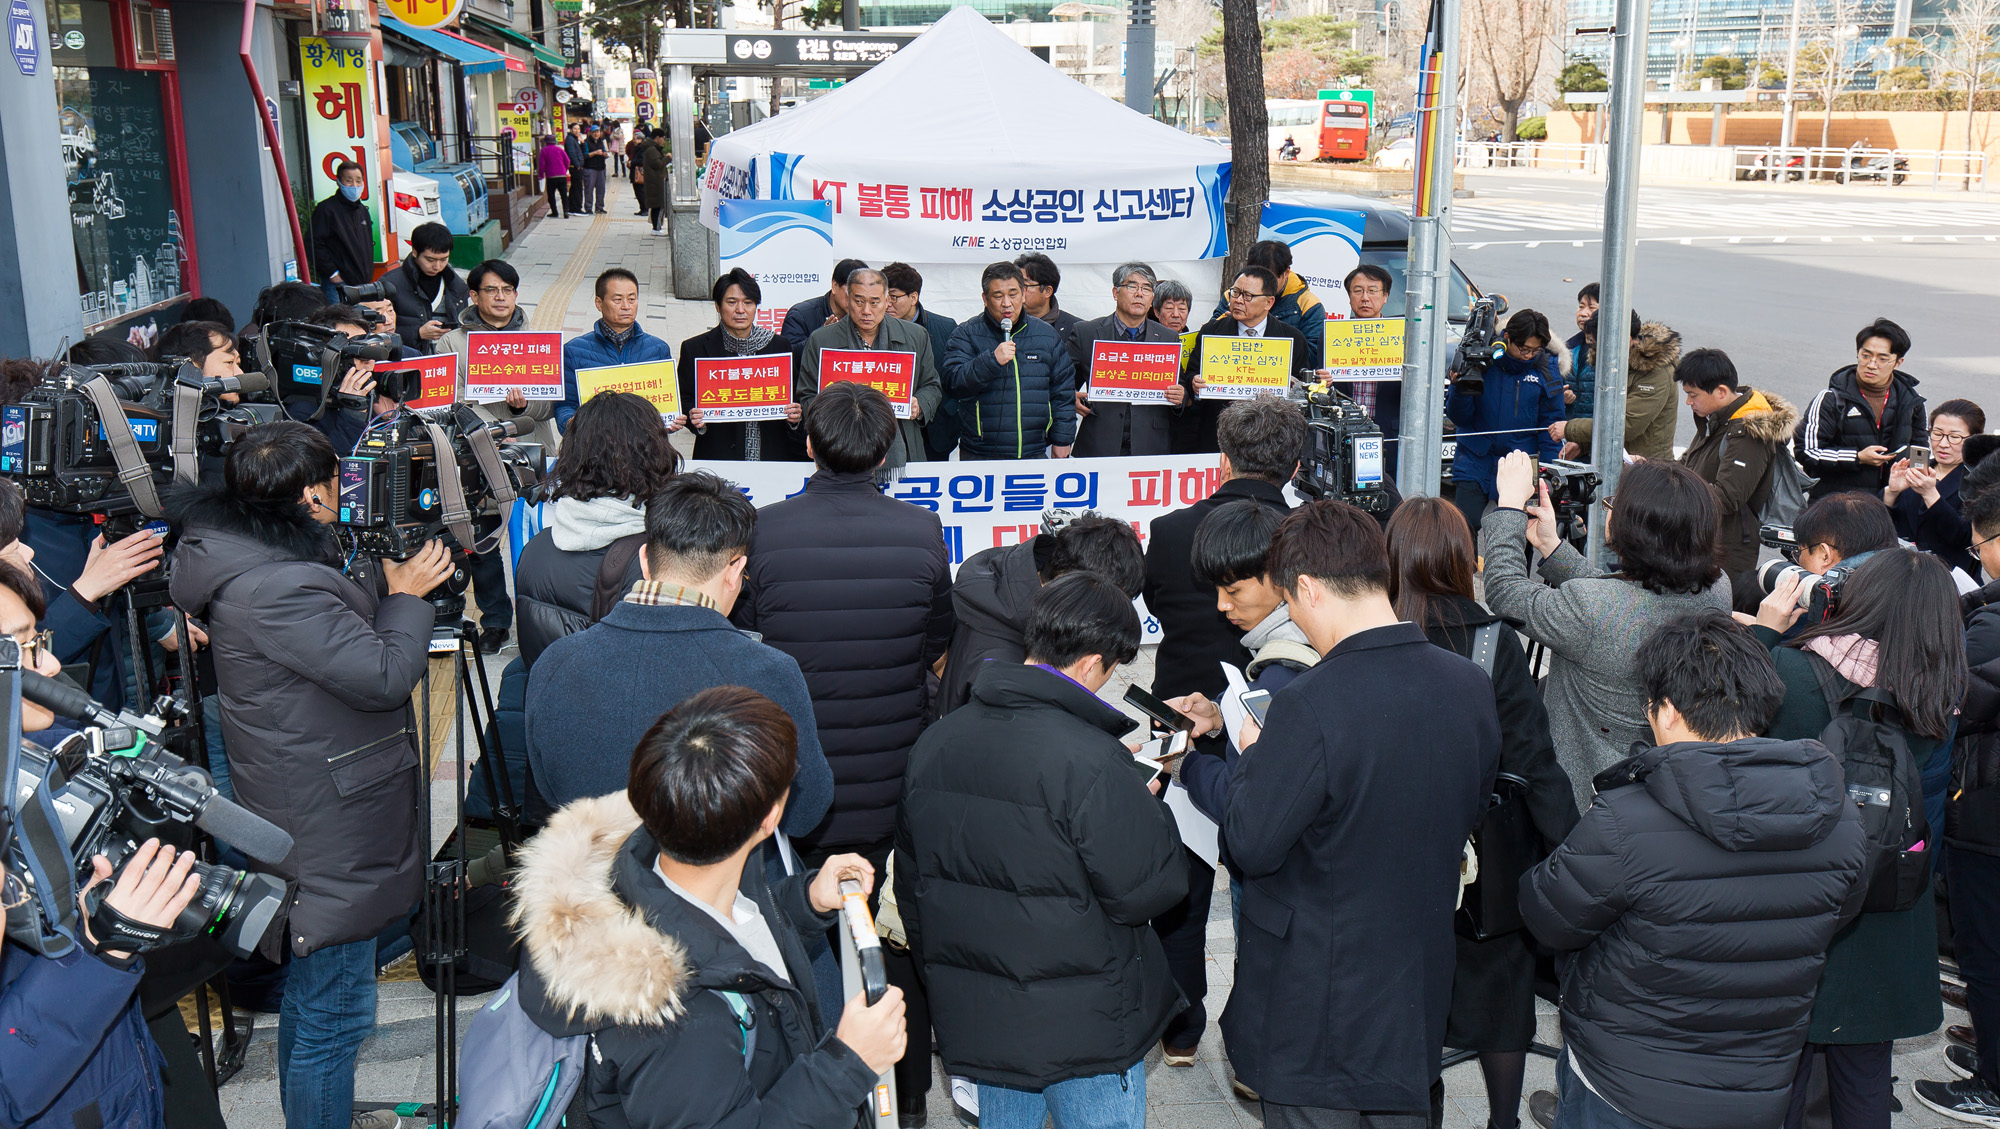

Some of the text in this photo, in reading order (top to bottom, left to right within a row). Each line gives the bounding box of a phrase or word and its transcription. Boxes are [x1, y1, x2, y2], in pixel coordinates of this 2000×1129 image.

[15, 23, 34, 50] ADT
[813, 179, 1195, 223] KT 불통 피해 소상공인 신고센터
[952, 236, 1067, 250] KFME 소상공인연합회
[762, 273, 820, 284] 소상공인연합회
[1303, 276, 1342, 289] 공인연합회
[1353, 323, 1385, 334] 답답한
[1231, 341, 1264, 352] 답답한
[1332, 335, 1405, 347] 소상공인 심정!
[477, 343, 551, 355] 소상공인 피해
[1359, 347, 1379, 355] KT는
[1097, 352, 1176, 364] 요금은 따박따박
[1209, 354, 1283, 366] 소상공인 심정!
[1332, 358, 1348, 366] 복구
[1350, 357, 1367, 365] 일정
[295, 367, 318, 378] OBS
[424, 367, 447, 378] 피해
[469, 363, 559, 376] 집단소송제 도입!
[709, 366, 779, 380] KT불통사태
[833, 361, 902, 374] KT불통사태
[1236, 366, 1256, 374] KT는
[1353, 367, 1403, 376] 소상공인연합
[1095, 370, 1175, 382] 보상은 미적미적
[1208, 374, 1283, 385] 복구 일정 제시하라!
[427, 385, 454, 398] 도입!
[472, 386, 557, 395] KFME 소인연합회
[701, 385, 786, 402] 소통도불통!
[1117, 390, 1164, 399] 소상공인연합
[645, 393, 674, 404] 하라
[130, 424, 157, 436] 제TV
[1360, 441, 1378, 450] KBS
[1127, 467, 1221, 507] 피해
[114, 923, 159, 939] FUJINON
